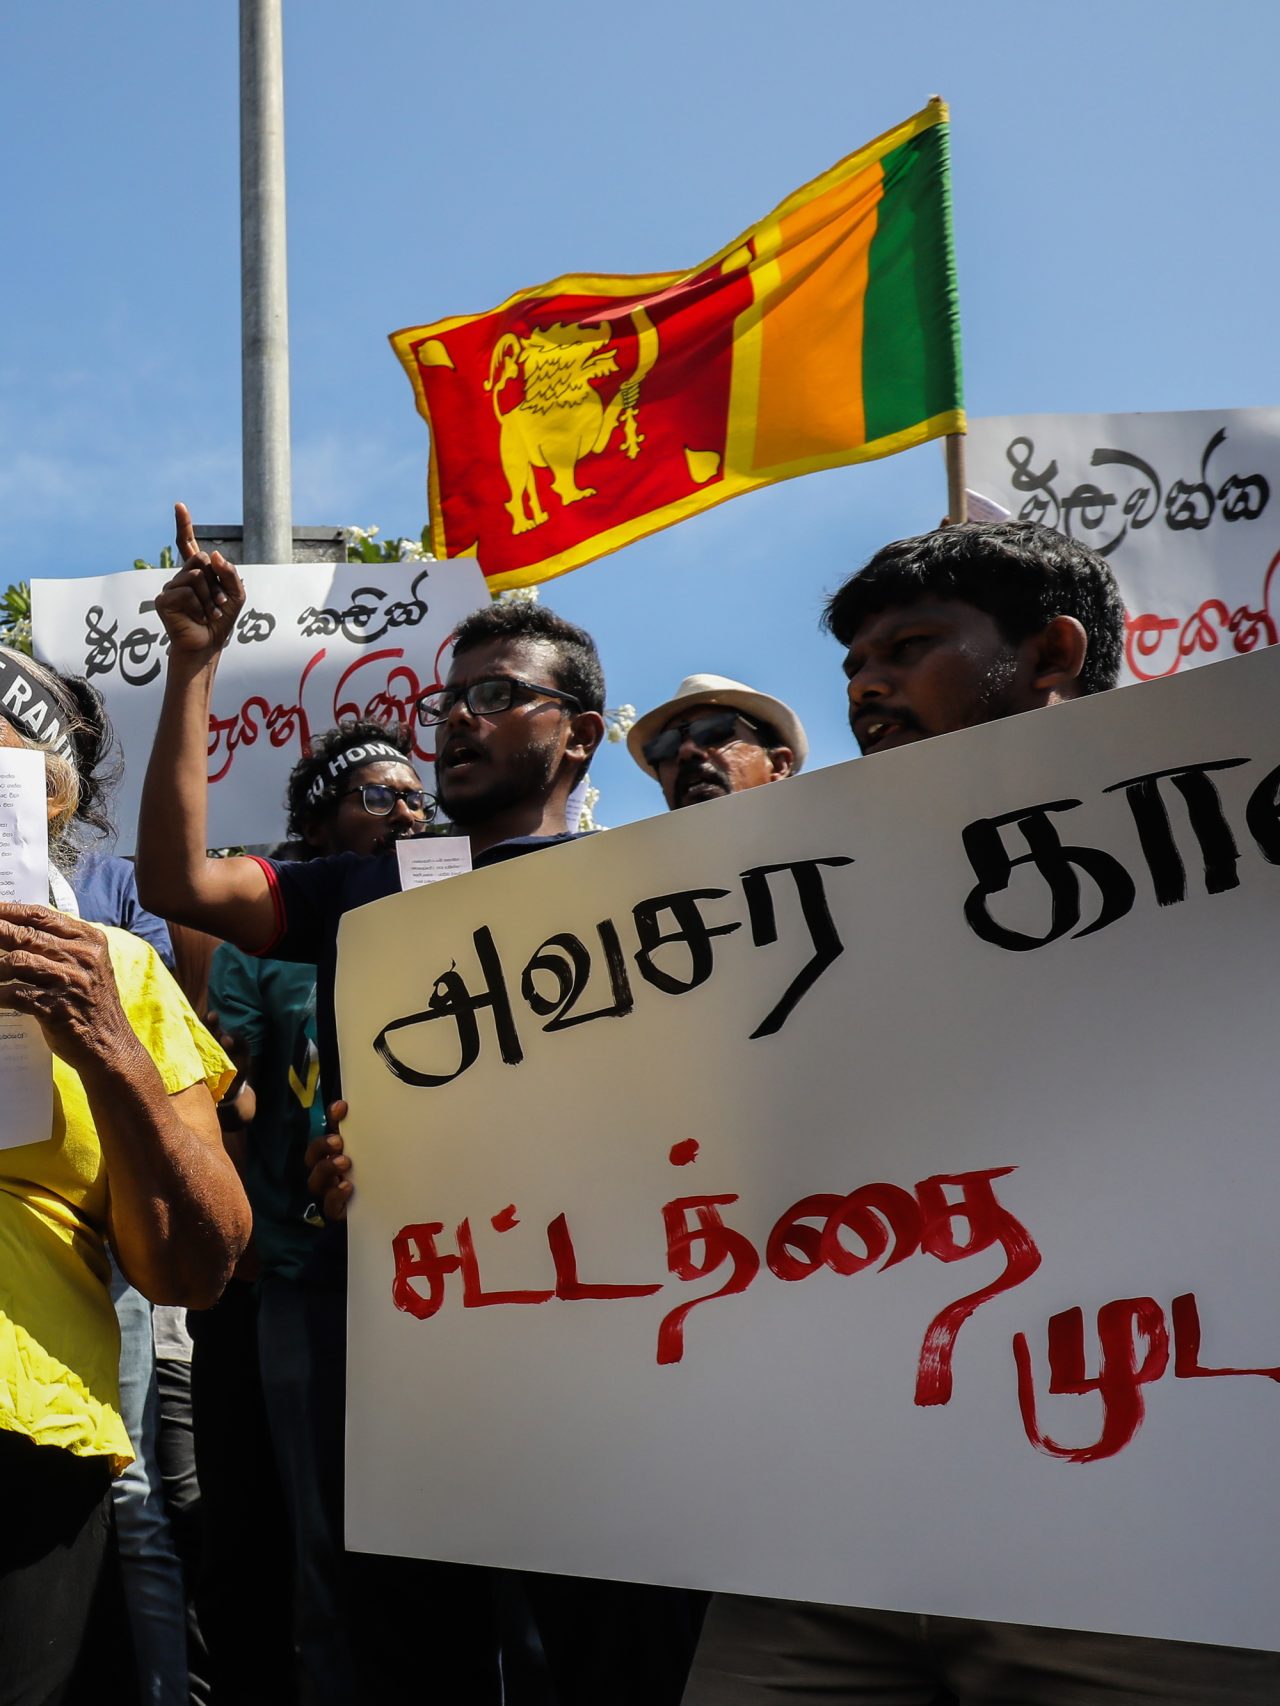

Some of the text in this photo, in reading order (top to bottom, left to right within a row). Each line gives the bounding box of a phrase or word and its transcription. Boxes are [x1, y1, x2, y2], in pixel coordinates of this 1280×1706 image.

[373, 757, 1280, 1087] அவசர கா
[393, 1138, 1042, 1406] சட்டத்தை
